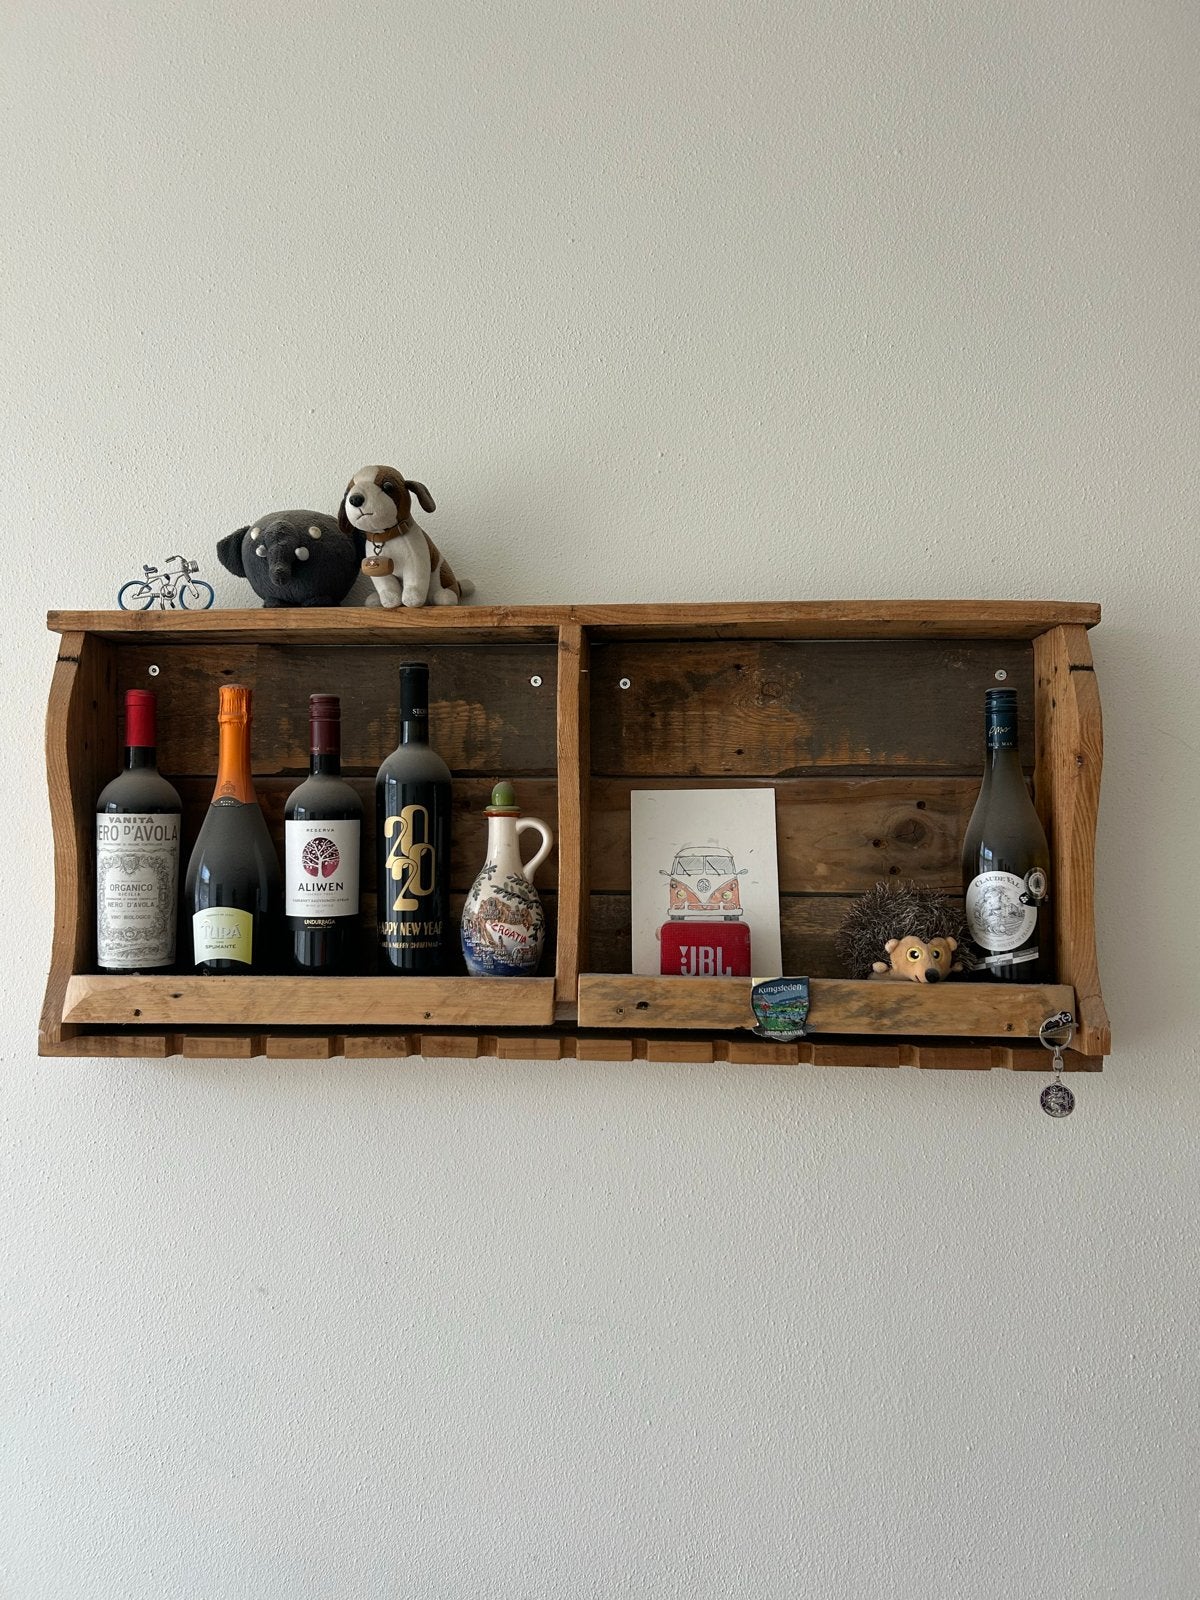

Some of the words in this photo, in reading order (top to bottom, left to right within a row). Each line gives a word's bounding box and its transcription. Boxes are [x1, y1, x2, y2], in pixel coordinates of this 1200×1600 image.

[97, 825, 119, 841] ERO
[298, 882, 344, 891] ALIWEN
[1003, 876, 1021, 888] VAL
[400, 921, 421, 936] NEW
[491, 922, 528, 944] CROATIA
[682, 946, 732, 976] JBL
